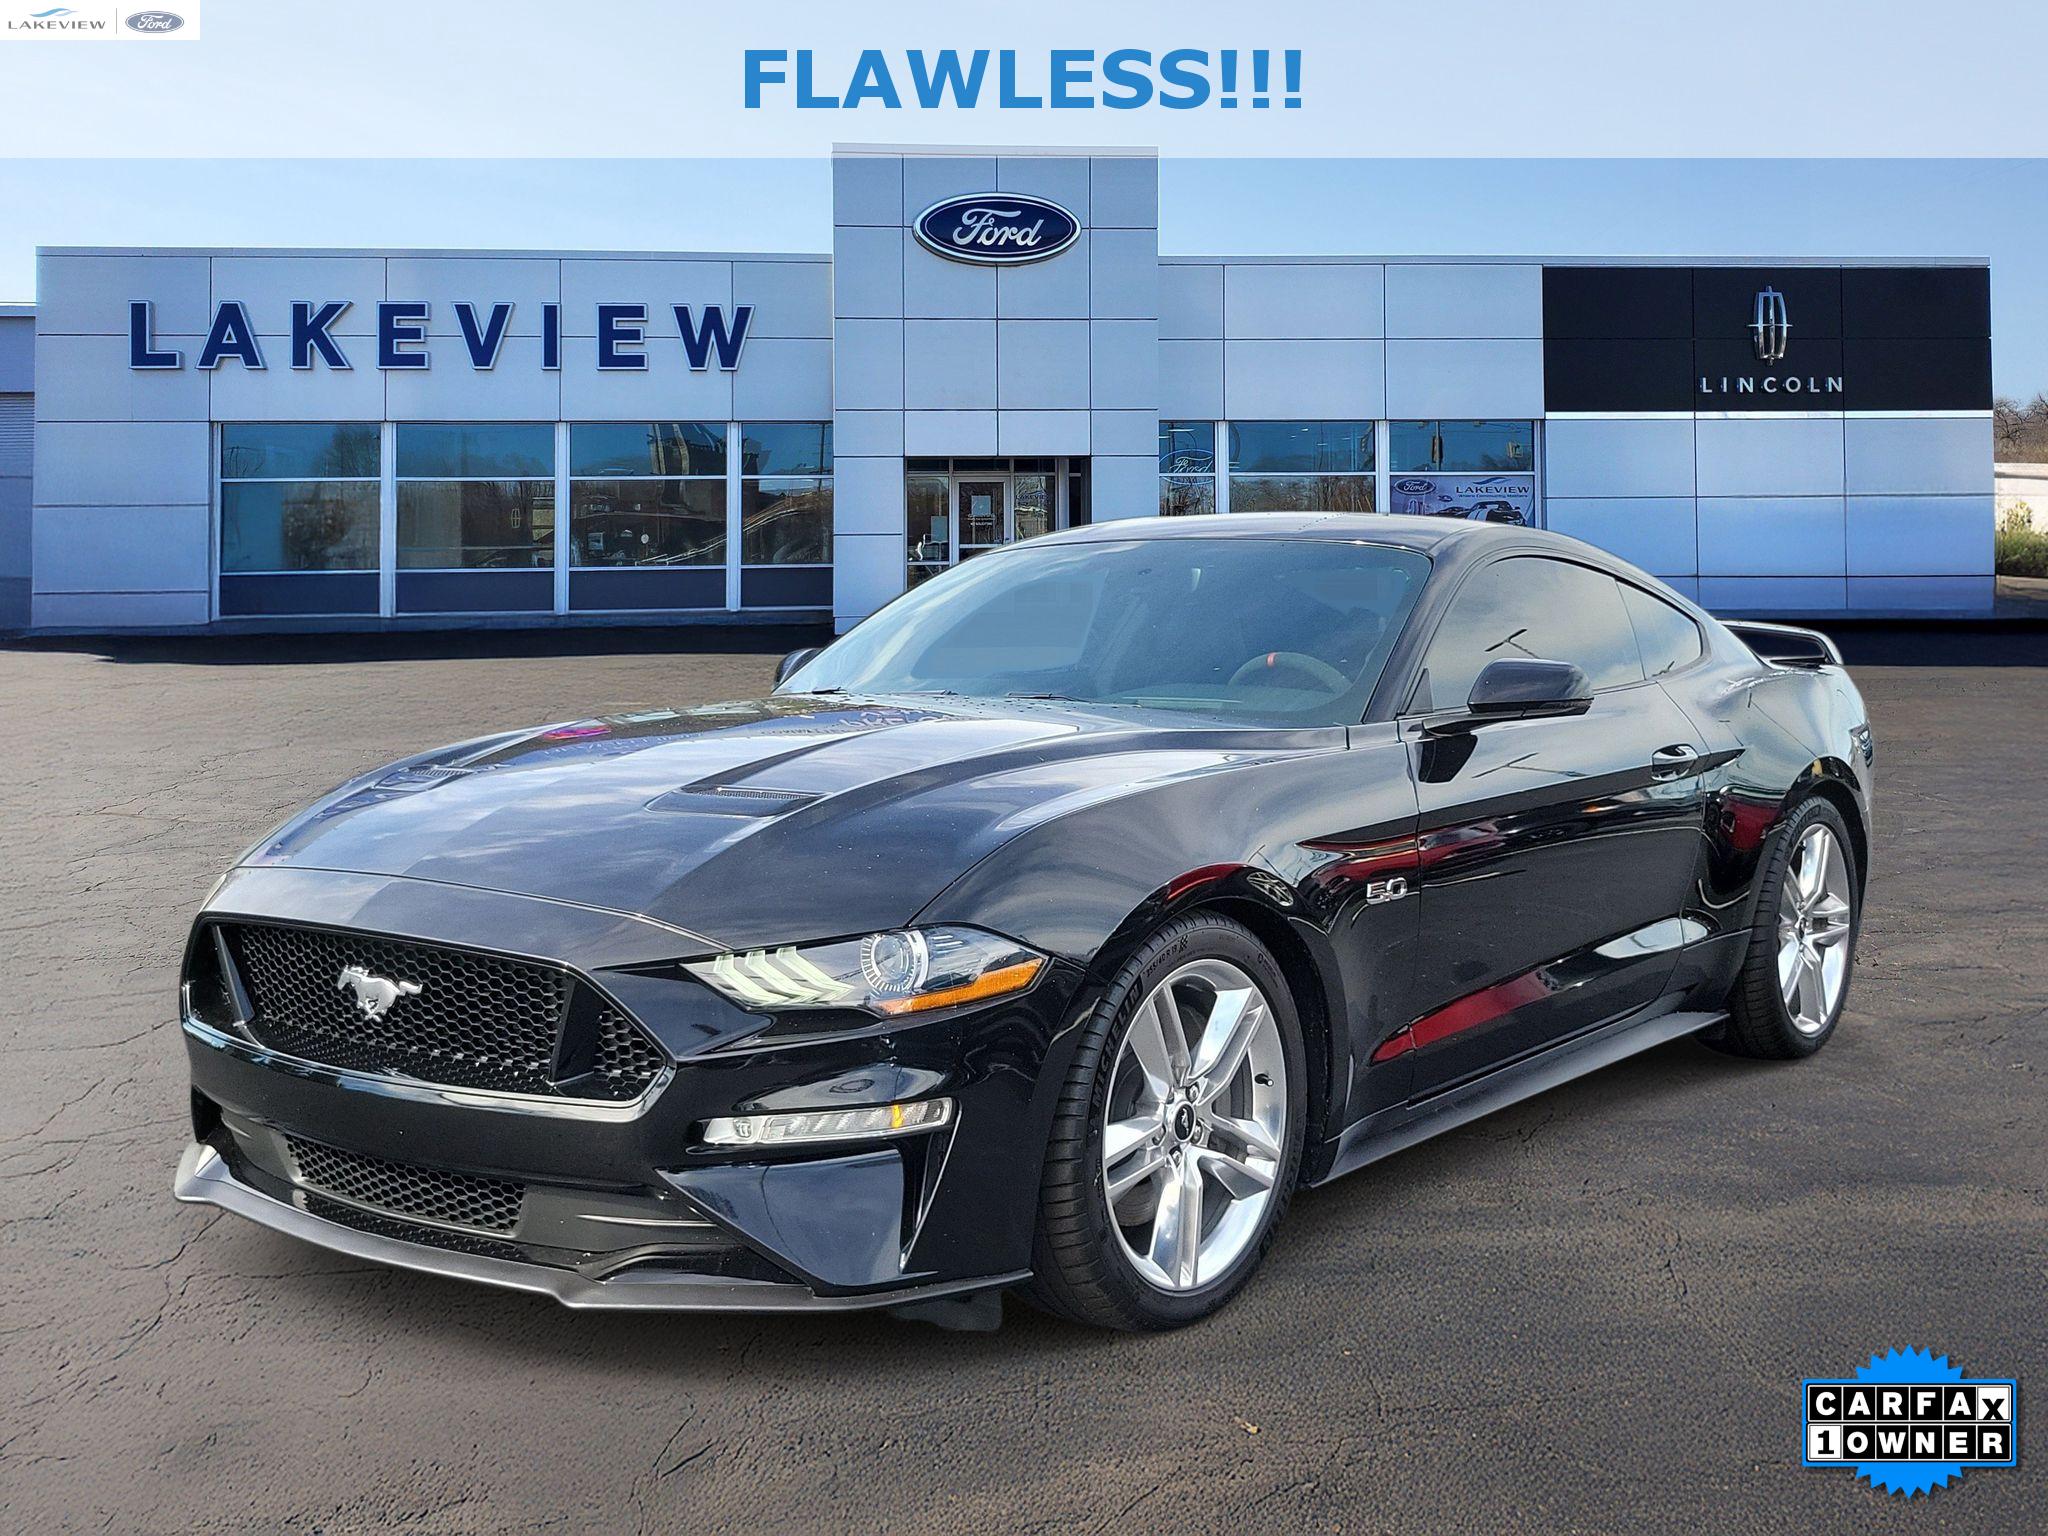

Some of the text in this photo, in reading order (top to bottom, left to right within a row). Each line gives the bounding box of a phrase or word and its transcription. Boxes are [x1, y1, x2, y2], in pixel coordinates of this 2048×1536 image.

[952, 208, 1044, 246] Ford
[127, 300, 756, 371] LAKEVIEW
[1701, 376, 1843, 393] LINCOLN
[1456, 486, 1530, 494] LAKEVIEW
[1092, 975, 1143, 1109] MICHELIN
